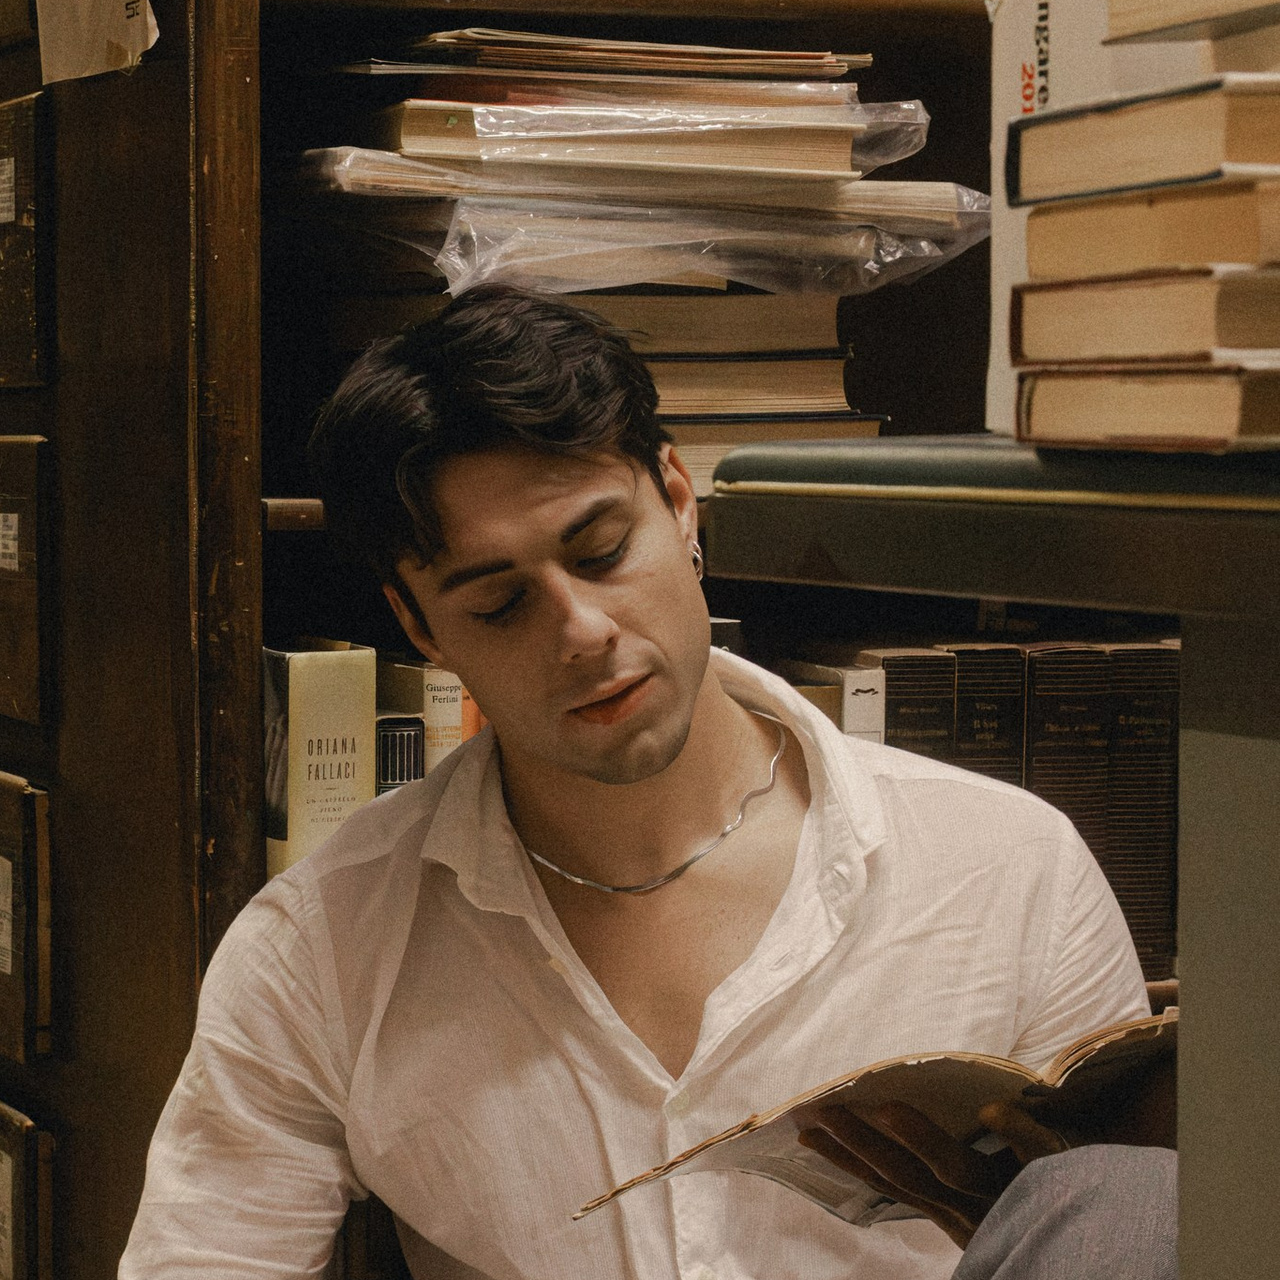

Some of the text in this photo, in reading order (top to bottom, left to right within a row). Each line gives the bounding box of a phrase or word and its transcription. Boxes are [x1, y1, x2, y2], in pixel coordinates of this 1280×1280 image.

[1022, 62, 1035, 114] 201
[426, 683, 462, 693] Giuseppe
[432, 695, 458, 704] Ferlini
[307, 737, 357, 757] ORIANA
[307, 762, 356, 781] FALLACI
